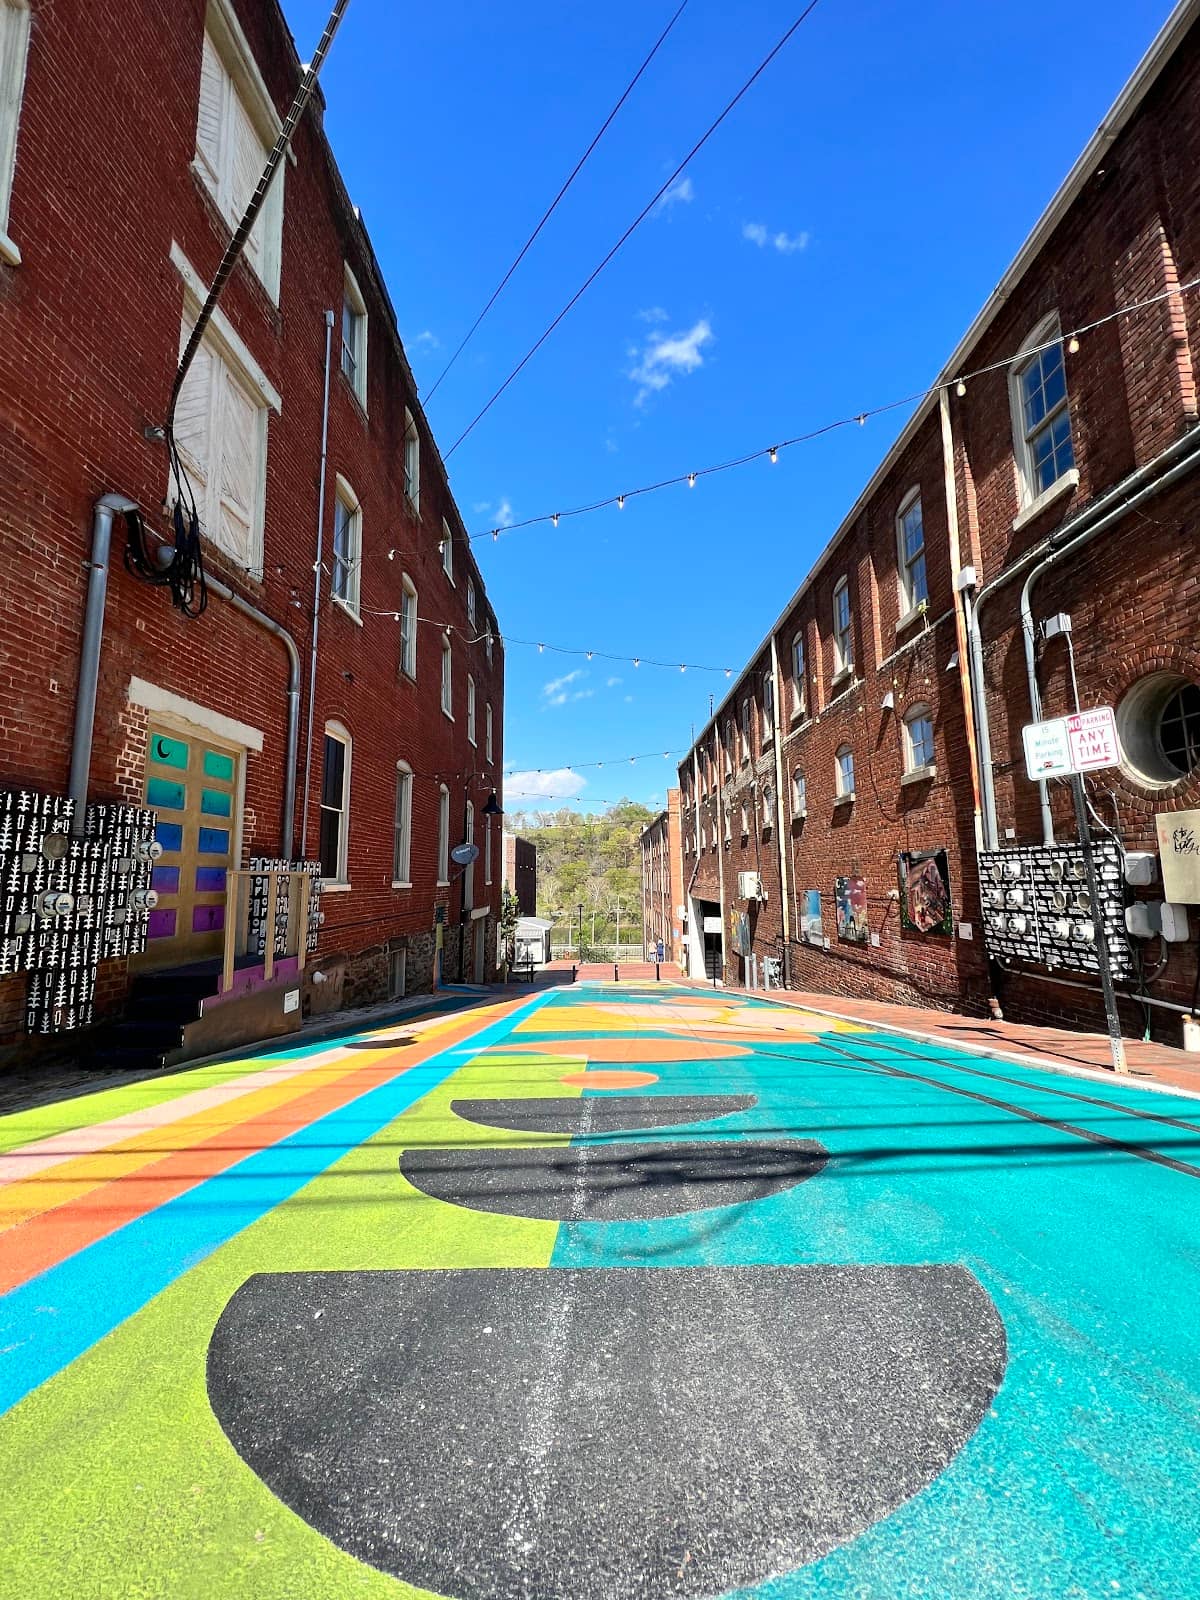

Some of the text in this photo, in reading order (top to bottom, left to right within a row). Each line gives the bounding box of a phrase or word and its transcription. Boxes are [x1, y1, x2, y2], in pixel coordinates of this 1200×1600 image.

[1068, 713, 1111, 731] NO PARKING
[1079, 729, 1105, 744] ANY
[1078, 742, 1111, 758] TIME
